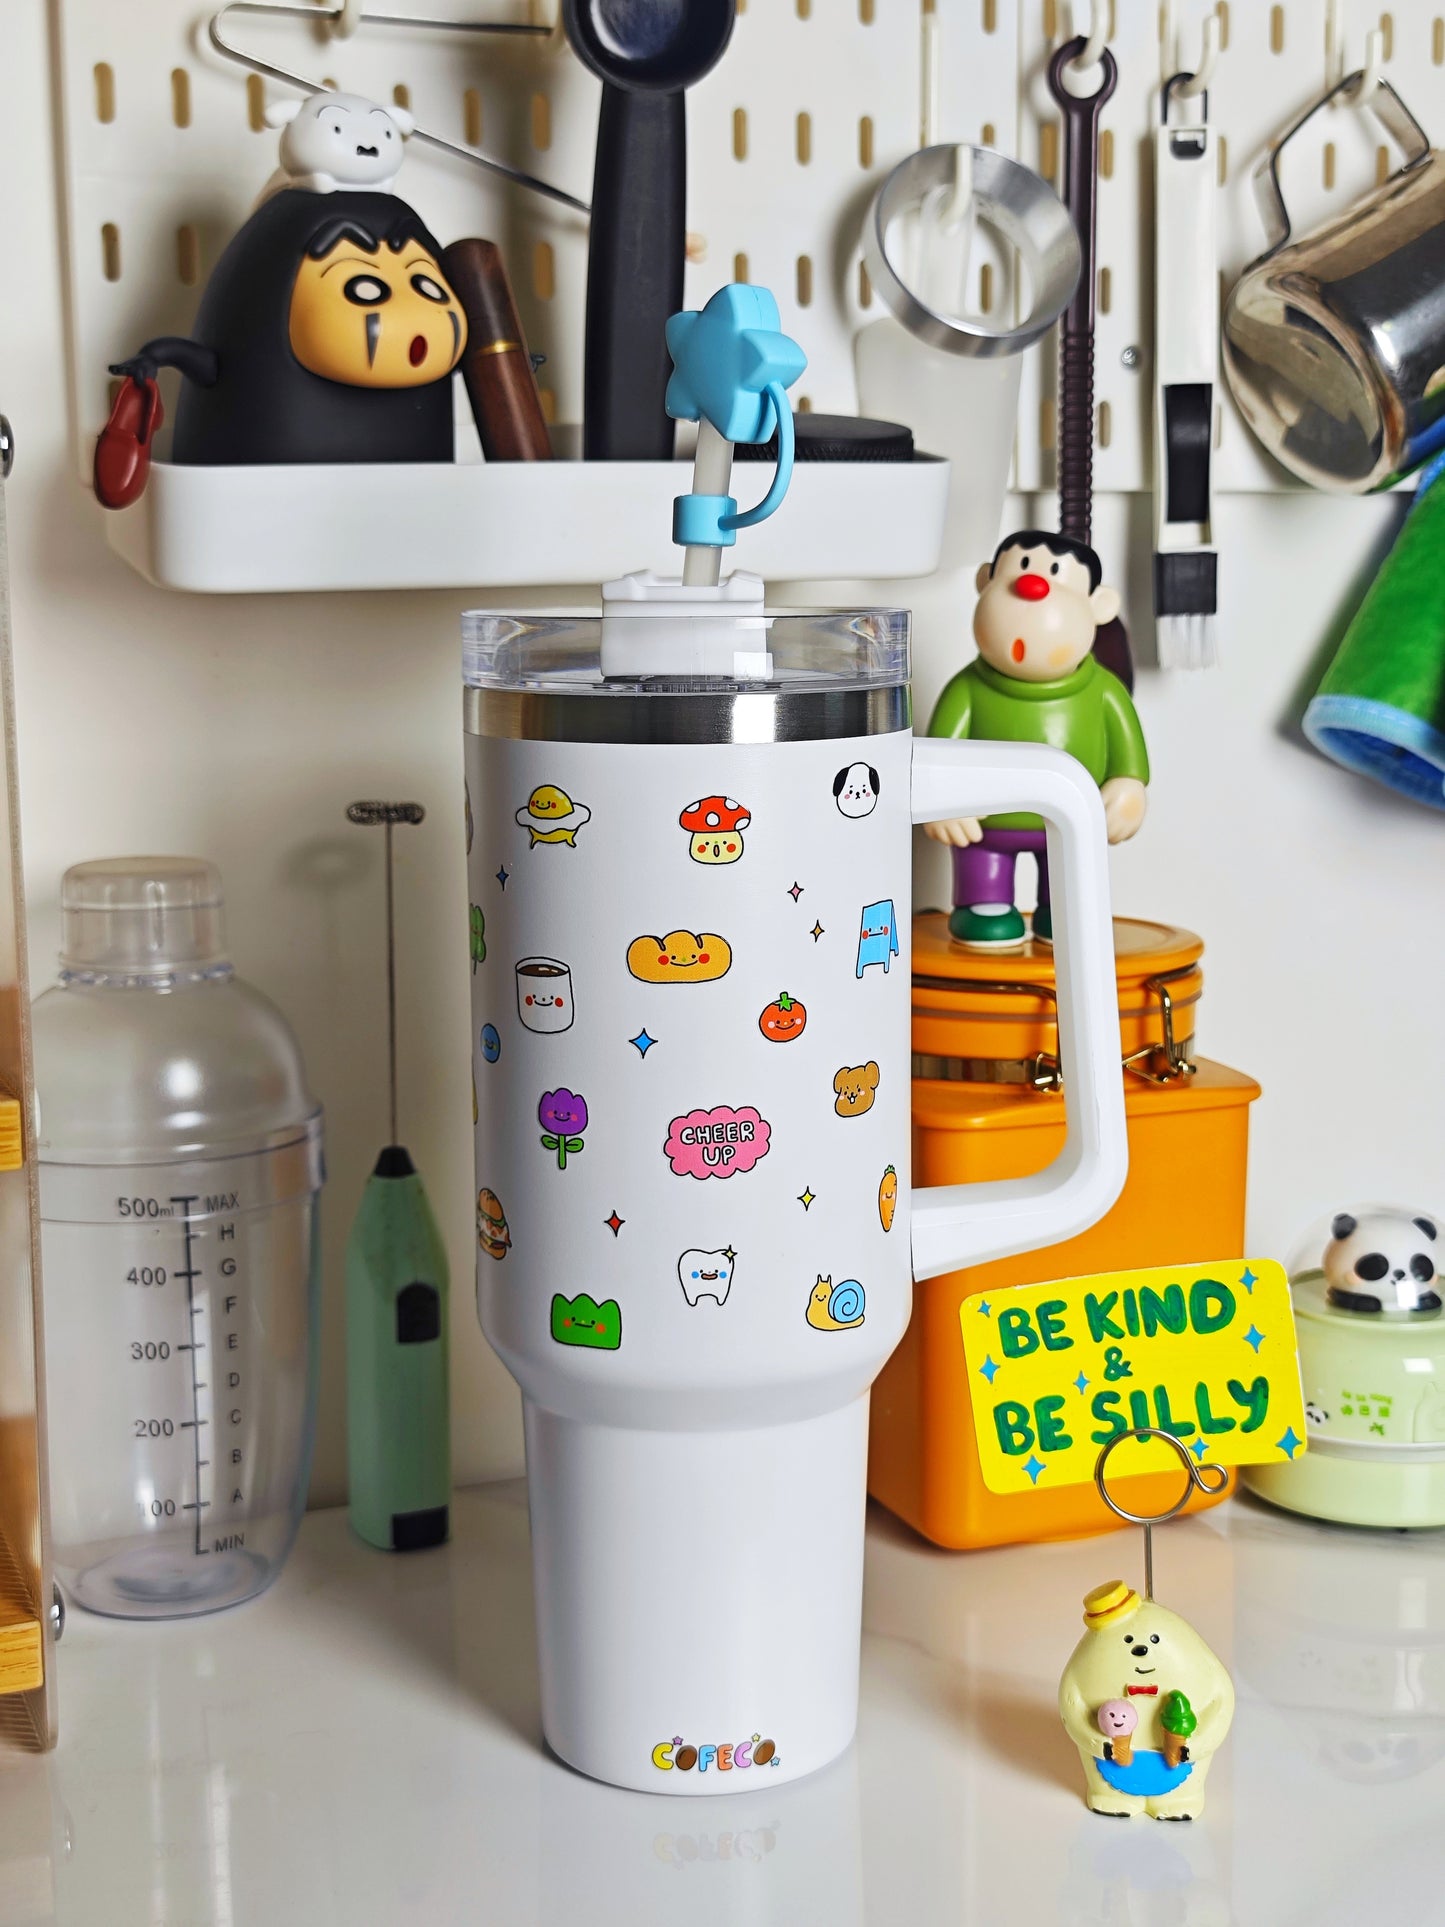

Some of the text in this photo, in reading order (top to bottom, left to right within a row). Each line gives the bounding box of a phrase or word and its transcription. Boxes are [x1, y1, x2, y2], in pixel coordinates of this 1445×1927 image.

[680, 1120, 755, 1145] CHEER
[702, 1145, 736, 1166] UP
[118, 1197, 175, 1218] 500ml
[206, 1192, 240, 1213] MAX
[221, 1224, 234, 1240] H
[126, 1266, 167, 1286] 400
[221, 1258, 236, 1275] G
[225, 1296, 237, 1313] F
[998, 1278, 1237, 1359] BE KIND
[130, 1341, 171, 1361] 300
[228, 1334, 238, 1349] E
[1102, 1345, 1134, 1382] &
[229, 1372, 240, 1387] D
[231, 1409, 241, 1424] C
[992, 1375, 1270, 1456] BE SILLY
[134, 1418, 174, 1438] 200
[232, 1448, 242, 1463] B
[232, 1488, 243, 1503] A
[215, 1533, 245, 1552] MIN
[652, 1738, 776, 1772] COFECO
